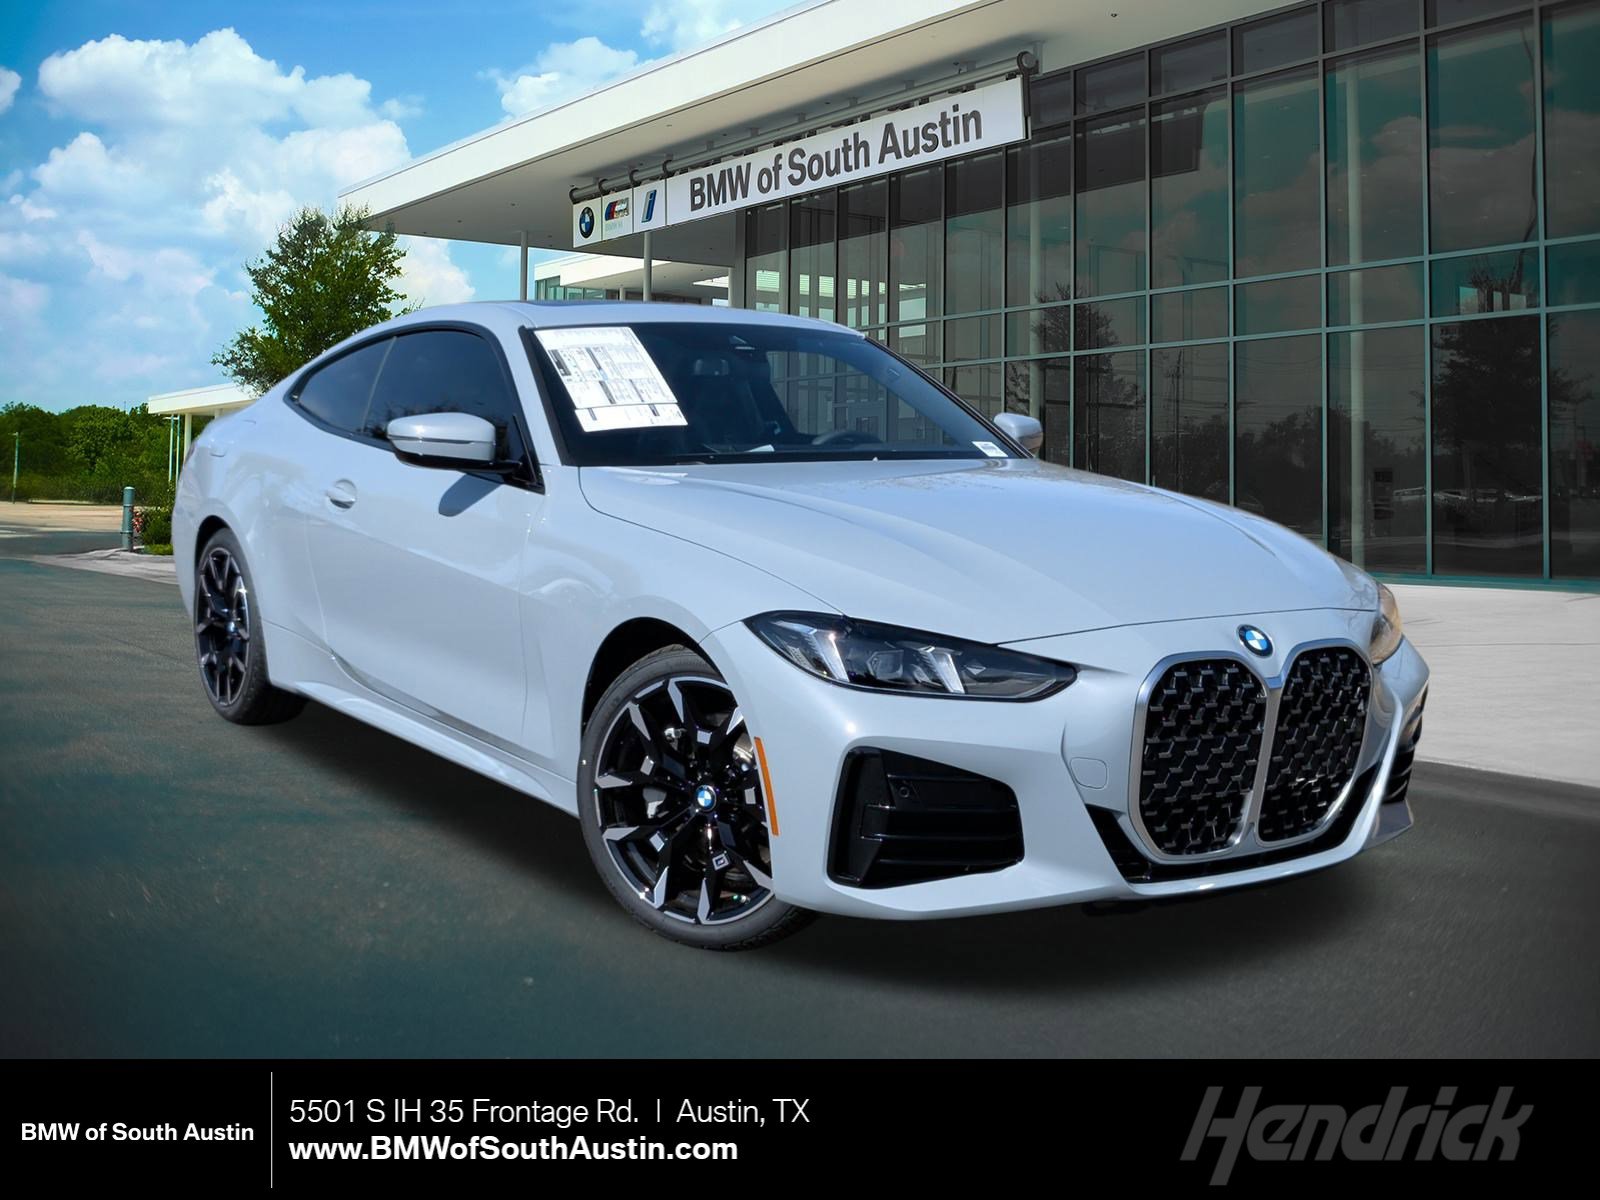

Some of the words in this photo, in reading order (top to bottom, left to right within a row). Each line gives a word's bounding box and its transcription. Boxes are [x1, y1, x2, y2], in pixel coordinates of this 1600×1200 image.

[689, 162, 752, 212] BMW
[757, 153, 783, 194] of
[787, 131, 871, 186] South
[878, 104, 982, 164] Austin
